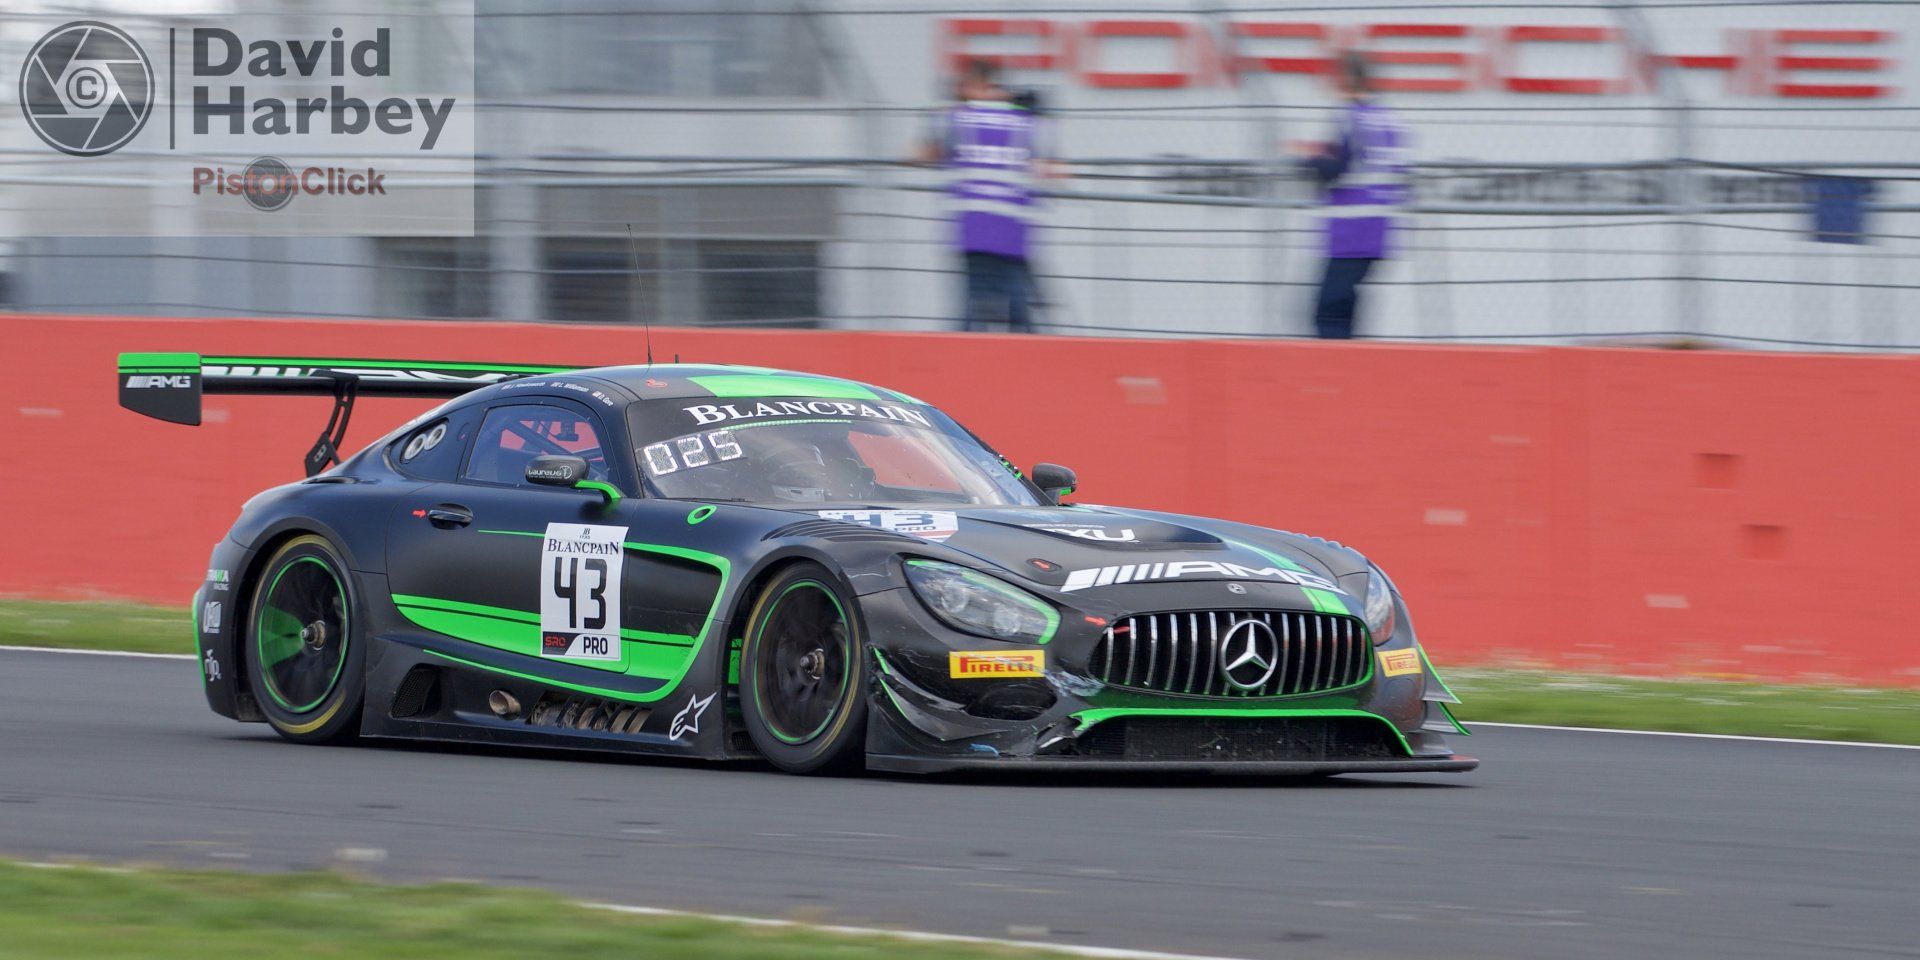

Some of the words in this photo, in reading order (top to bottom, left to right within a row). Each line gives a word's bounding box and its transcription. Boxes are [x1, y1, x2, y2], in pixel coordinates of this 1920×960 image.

[938, 17, 1896, 99] PORSCHE
[149, 375, 191, 388] AMG
[683, 402, 933, 427] BLANCPAIN
[644, 430, 742, 476] 025
[547, 538, 619, 555] BLANCPAIN
[1164, 561, 1349, 595] AMG
[554, 556, 607, 630] 43
[583, 636, 608, 655] PRO
[960, 655, 1034, 673] PIRELLI
